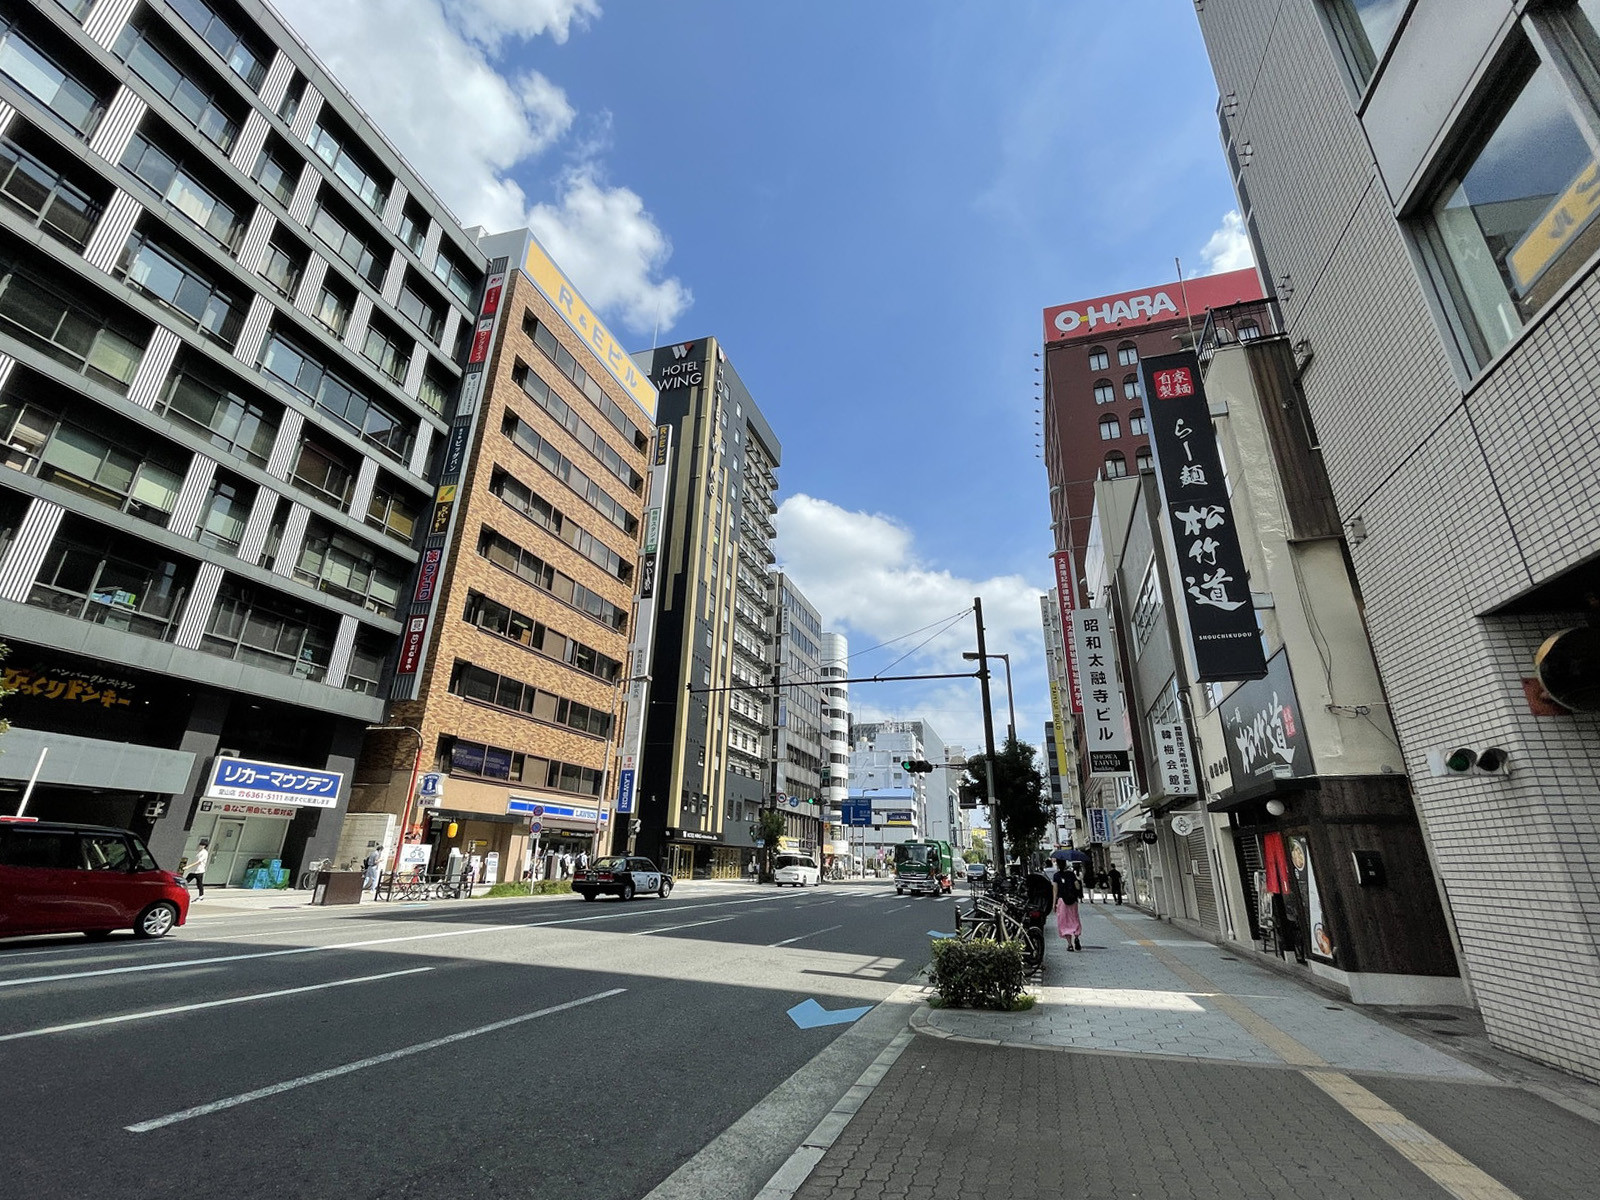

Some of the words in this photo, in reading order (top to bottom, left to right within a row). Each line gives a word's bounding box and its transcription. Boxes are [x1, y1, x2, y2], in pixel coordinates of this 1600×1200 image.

[657, 372, 702, 391] WING
[662, 361, 699, 377] HOTEL
[1174, 503, 1247, 612] 松竹道
[4, 667, 131, 708] びっくりドンキー
[1083, 618, 1114, 742] 昭和太融寺ビル
[1235, 691, 1296, 774] 松竹道
[224, 765, 334, 792] リカーマウンテン
[621, 773, 632, 809] LAWSON
